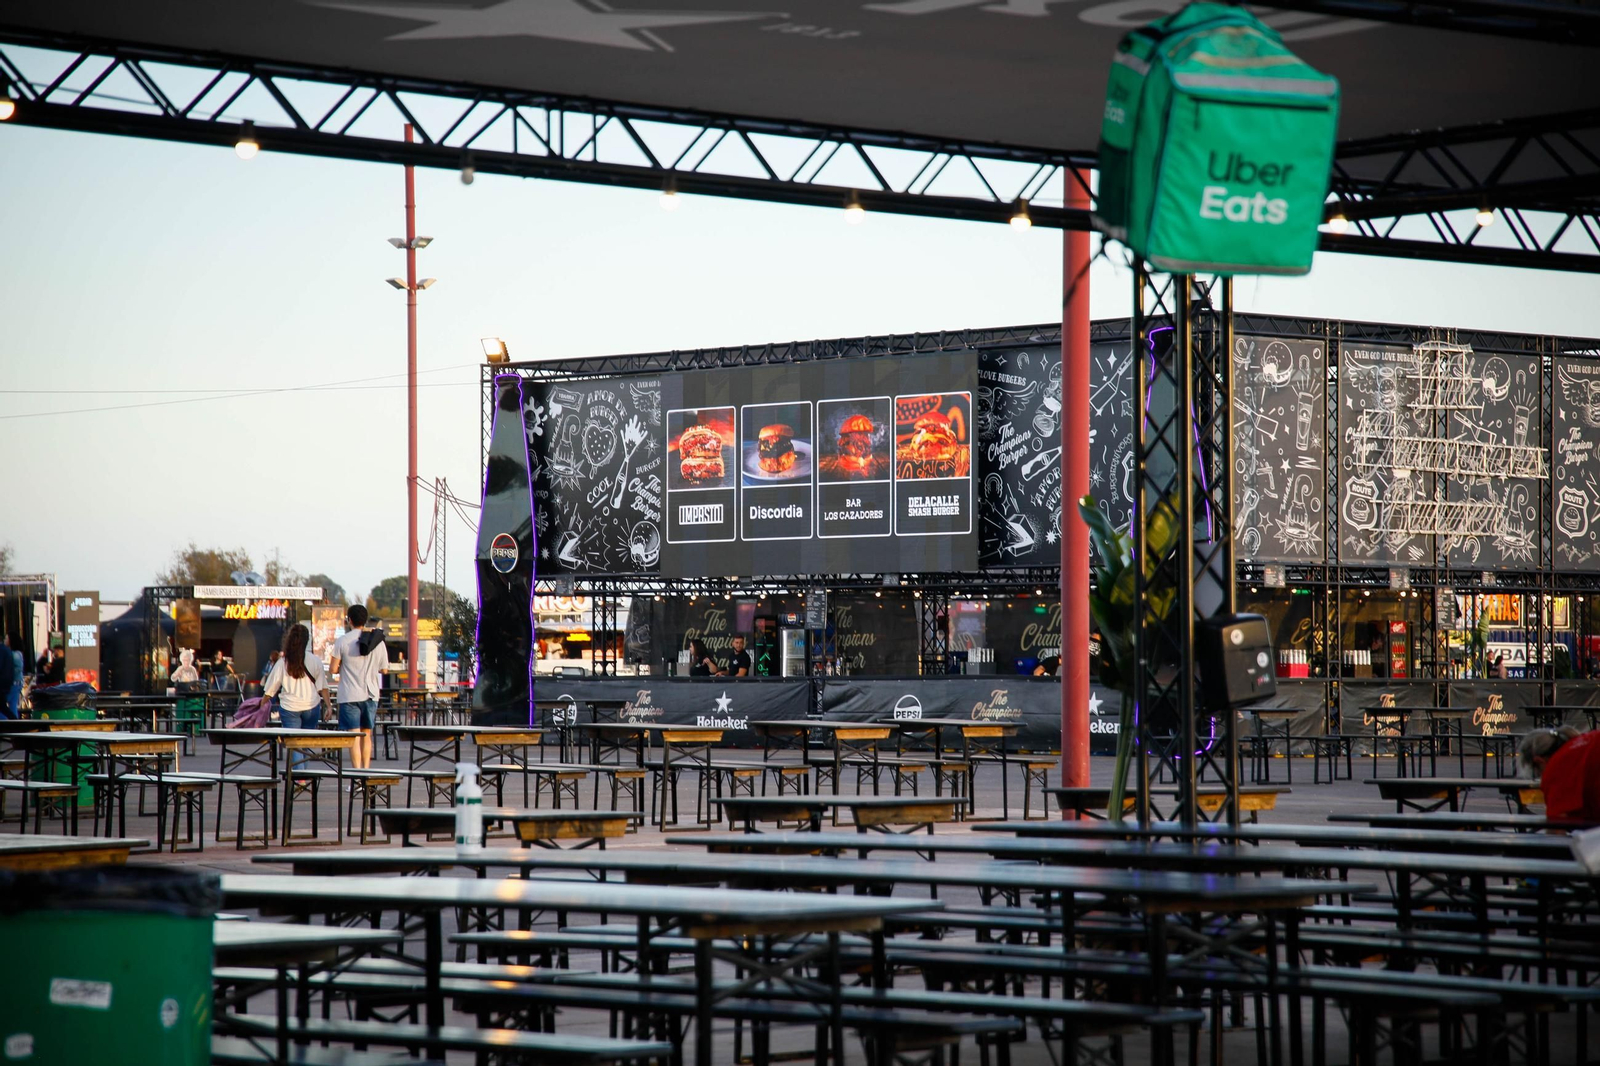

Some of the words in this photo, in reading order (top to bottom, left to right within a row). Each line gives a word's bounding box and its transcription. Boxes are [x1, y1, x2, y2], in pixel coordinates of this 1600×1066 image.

[1207, 150, 1294, 187] Uber
[1199, 185, 1288, 224] Eats
[1381, 352, 1396, 361] LOVE
[1567, 364, 1581, 373] EVEN
[1581, 365, 1591, 374] GOD
[980, 370, 997, 381] LOVE
[997, 372, 1027, 387] BURGERS
[587, 389, 615, 406] AMOR
[615, 398, 628, 421] DE
[589, 405, 618, 428] BURGER
[998, 421, 1015, 445] The
[1569, 427, 1582, 442] The
[987, 430, 1032, 462] Champions
[1558, 438, 1593, 455] Champions
[635, 457, 661, 475] BURGER
[998, 444, 1029, 471] Burger
[1564, 451, 1589, 467] Burger
[586, 477, 613, 503] COOL
[645, 474, 661, 494] The
[1034, 466, 1062, 507] AMOR
[1351, 484, 1373, 496] ROUTE
[846, 498, 861, 508] BAR
[908, 495, 960, 508] DELACALLE
[1564, 493, 1583, 504] ROUTE
[630, 495, 661, 523] Burger
[679, 504, 723, 525] IMPASTO
[749, 505, 803, 520] Discordia
[824, 512, 838, 521] LOS
[839, 510, 883, 521] CAZADORES
[908, 507, 931, 517] SMASH
[932, 506, 960, 516] BURGER
[492, 547, 516, 559] PEPSI
[224, 604, 256, 620] NOLA
[256, 605, 287, 619] SMOKE
[704, 609, 727, 635] The
[635, 690, 651, 707] The
[989, 690, 1008, 708] The
[1488, 694, 1503, 713] The
[620, 701, 665, 719] Champions
[896, 710, 920, 719] PEPSI
[971, 702, 1022, 720] Champions
[1473, 706, 1518, 725] Champions
